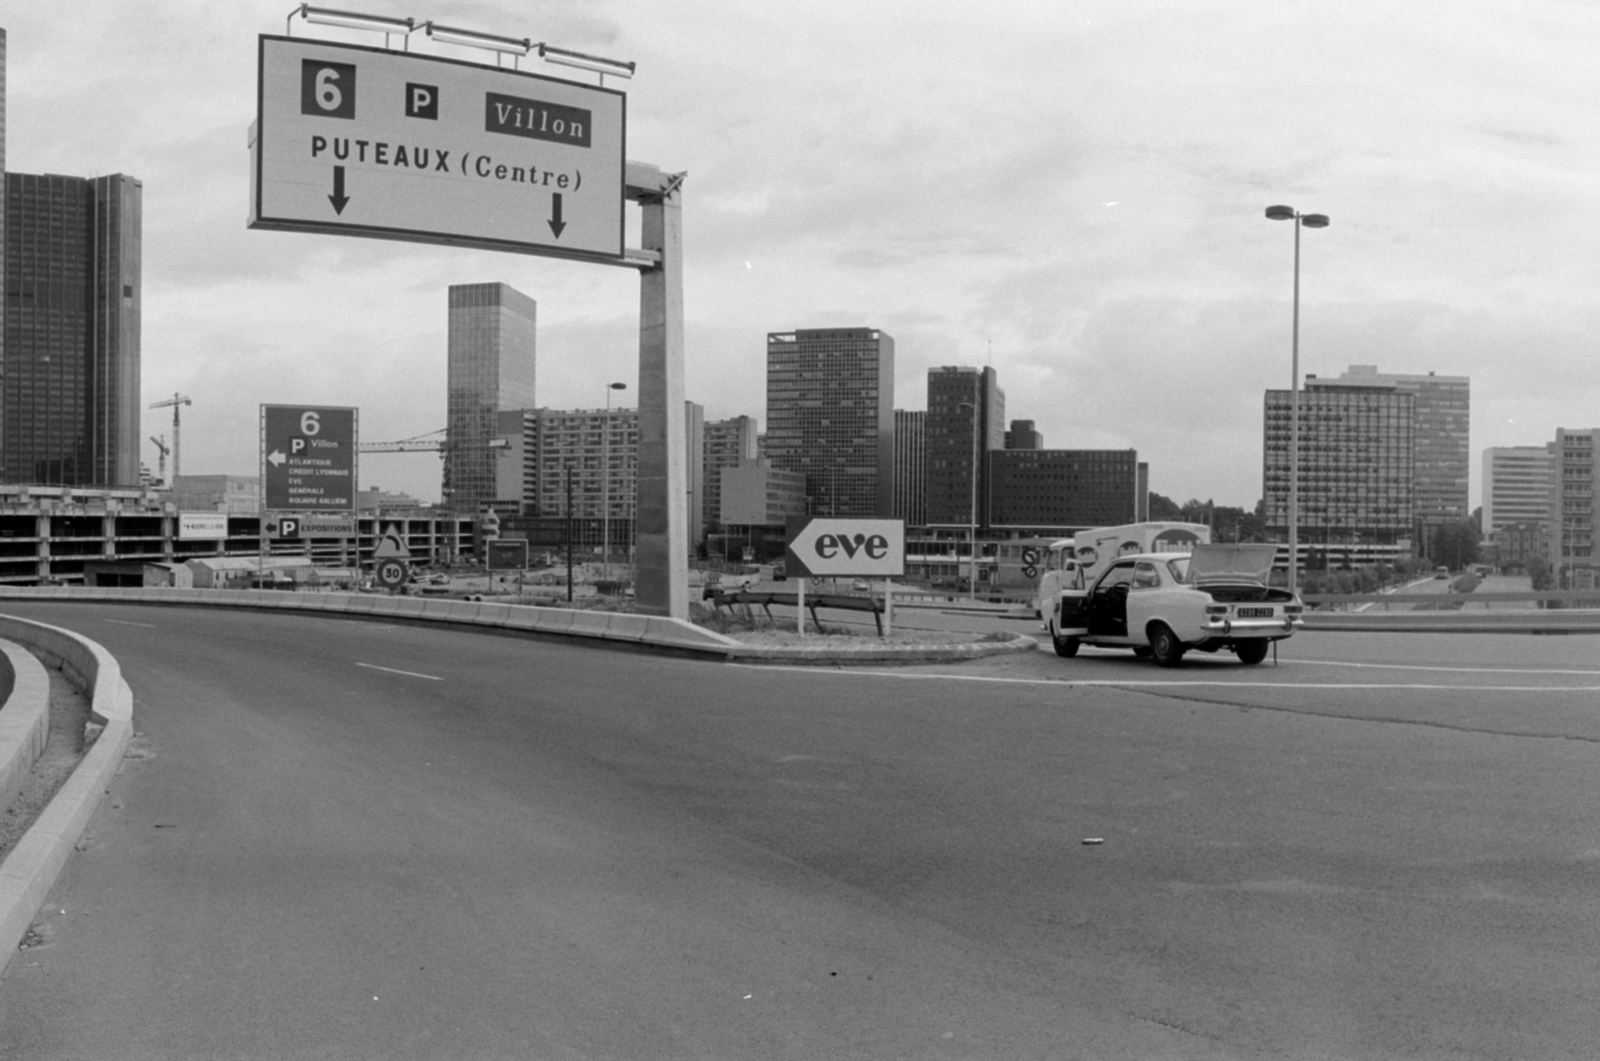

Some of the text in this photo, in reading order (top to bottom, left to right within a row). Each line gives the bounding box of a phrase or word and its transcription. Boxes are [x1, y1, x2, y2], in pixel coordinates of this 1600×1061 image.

[315, 67, 586, 139] 6 P Villon
[311, 134, 583, 193] PUTEAUX (Centre)
[301, 411, 320, 435] 6
[291, 438, 338, 454] P Villon
[289, 458, 332, 466] ATLANTIQUE
[315, 469, 349, 477] LYONNAIS
[289, 497, 317, 505] SQUARE
[282, 521, 353, 536] P EXPOSITIONS
[814, 532, 889, 560] eve
[385, 567, 400, 579] 30
